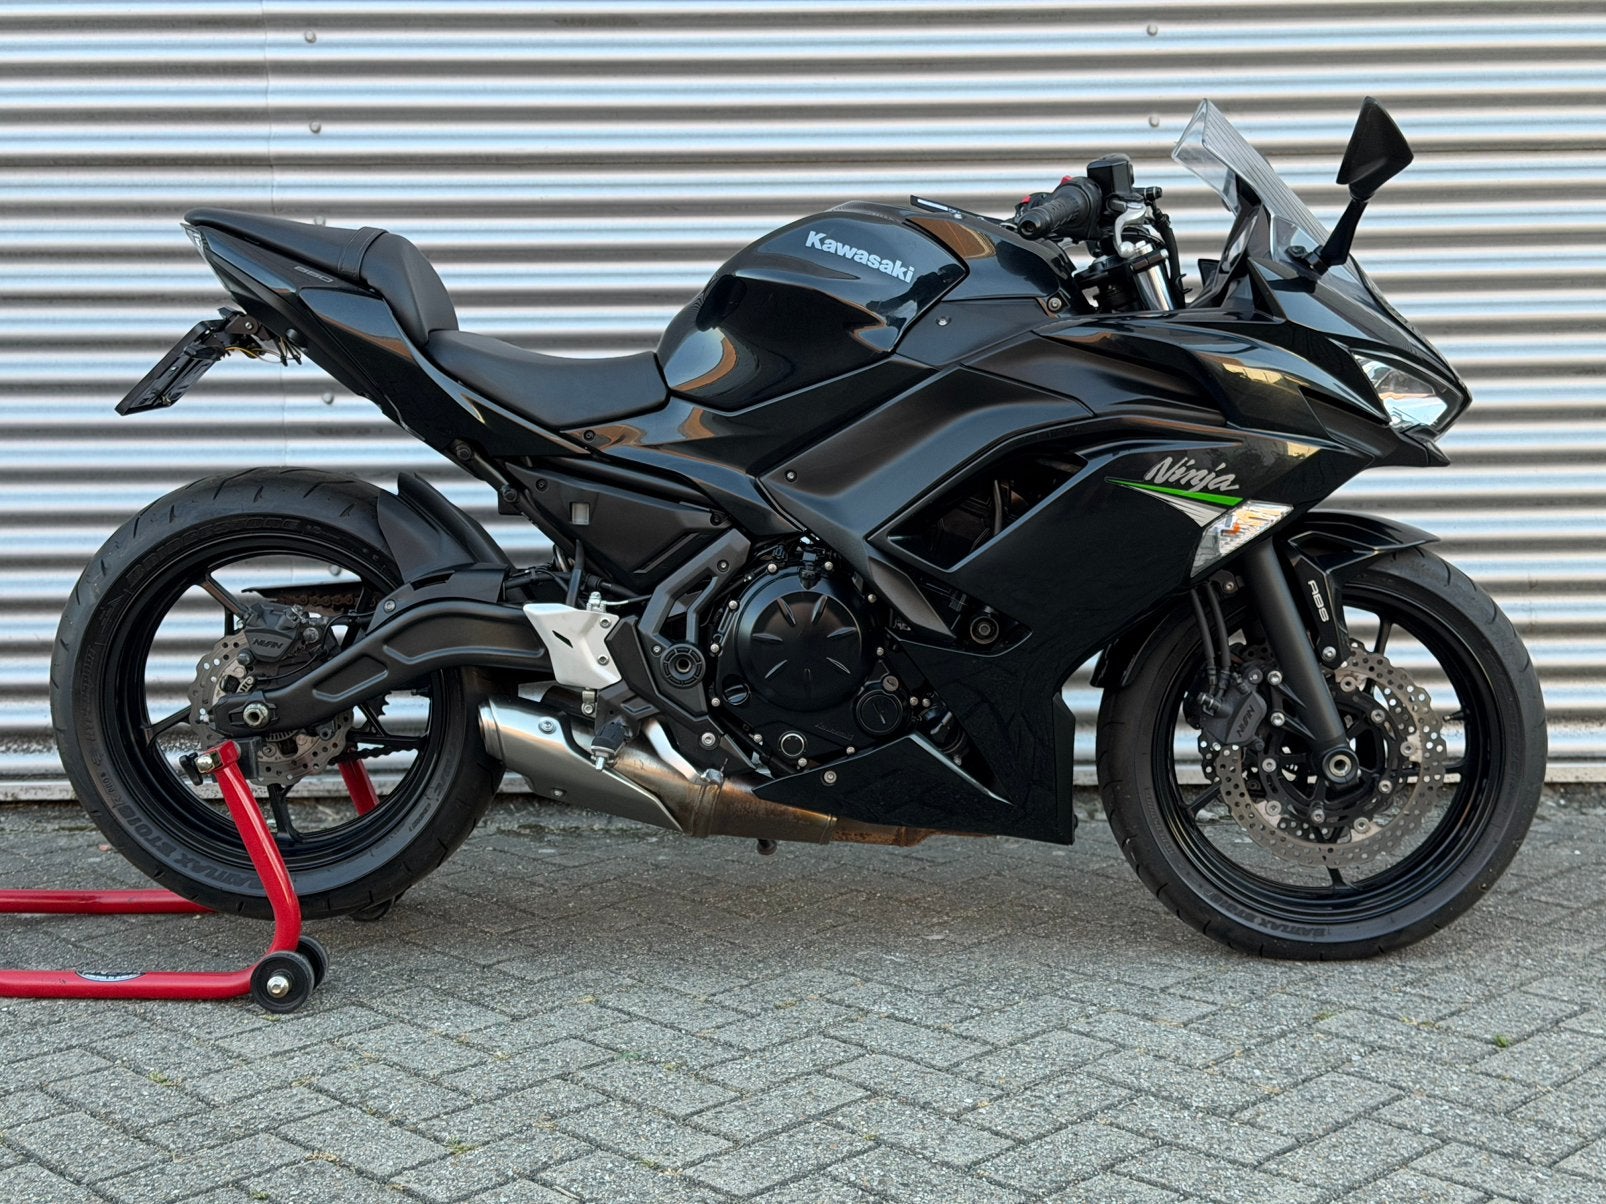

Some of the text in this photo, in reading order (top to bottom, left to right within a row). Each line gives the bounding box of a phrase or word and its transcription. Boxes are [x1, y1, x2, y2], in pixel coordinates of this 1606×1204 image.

[805, 230, 915, 283] Kawasaki
[1144, 456, 1240, 494] Ninja
[1308, 579, 1330, 623] ABS
